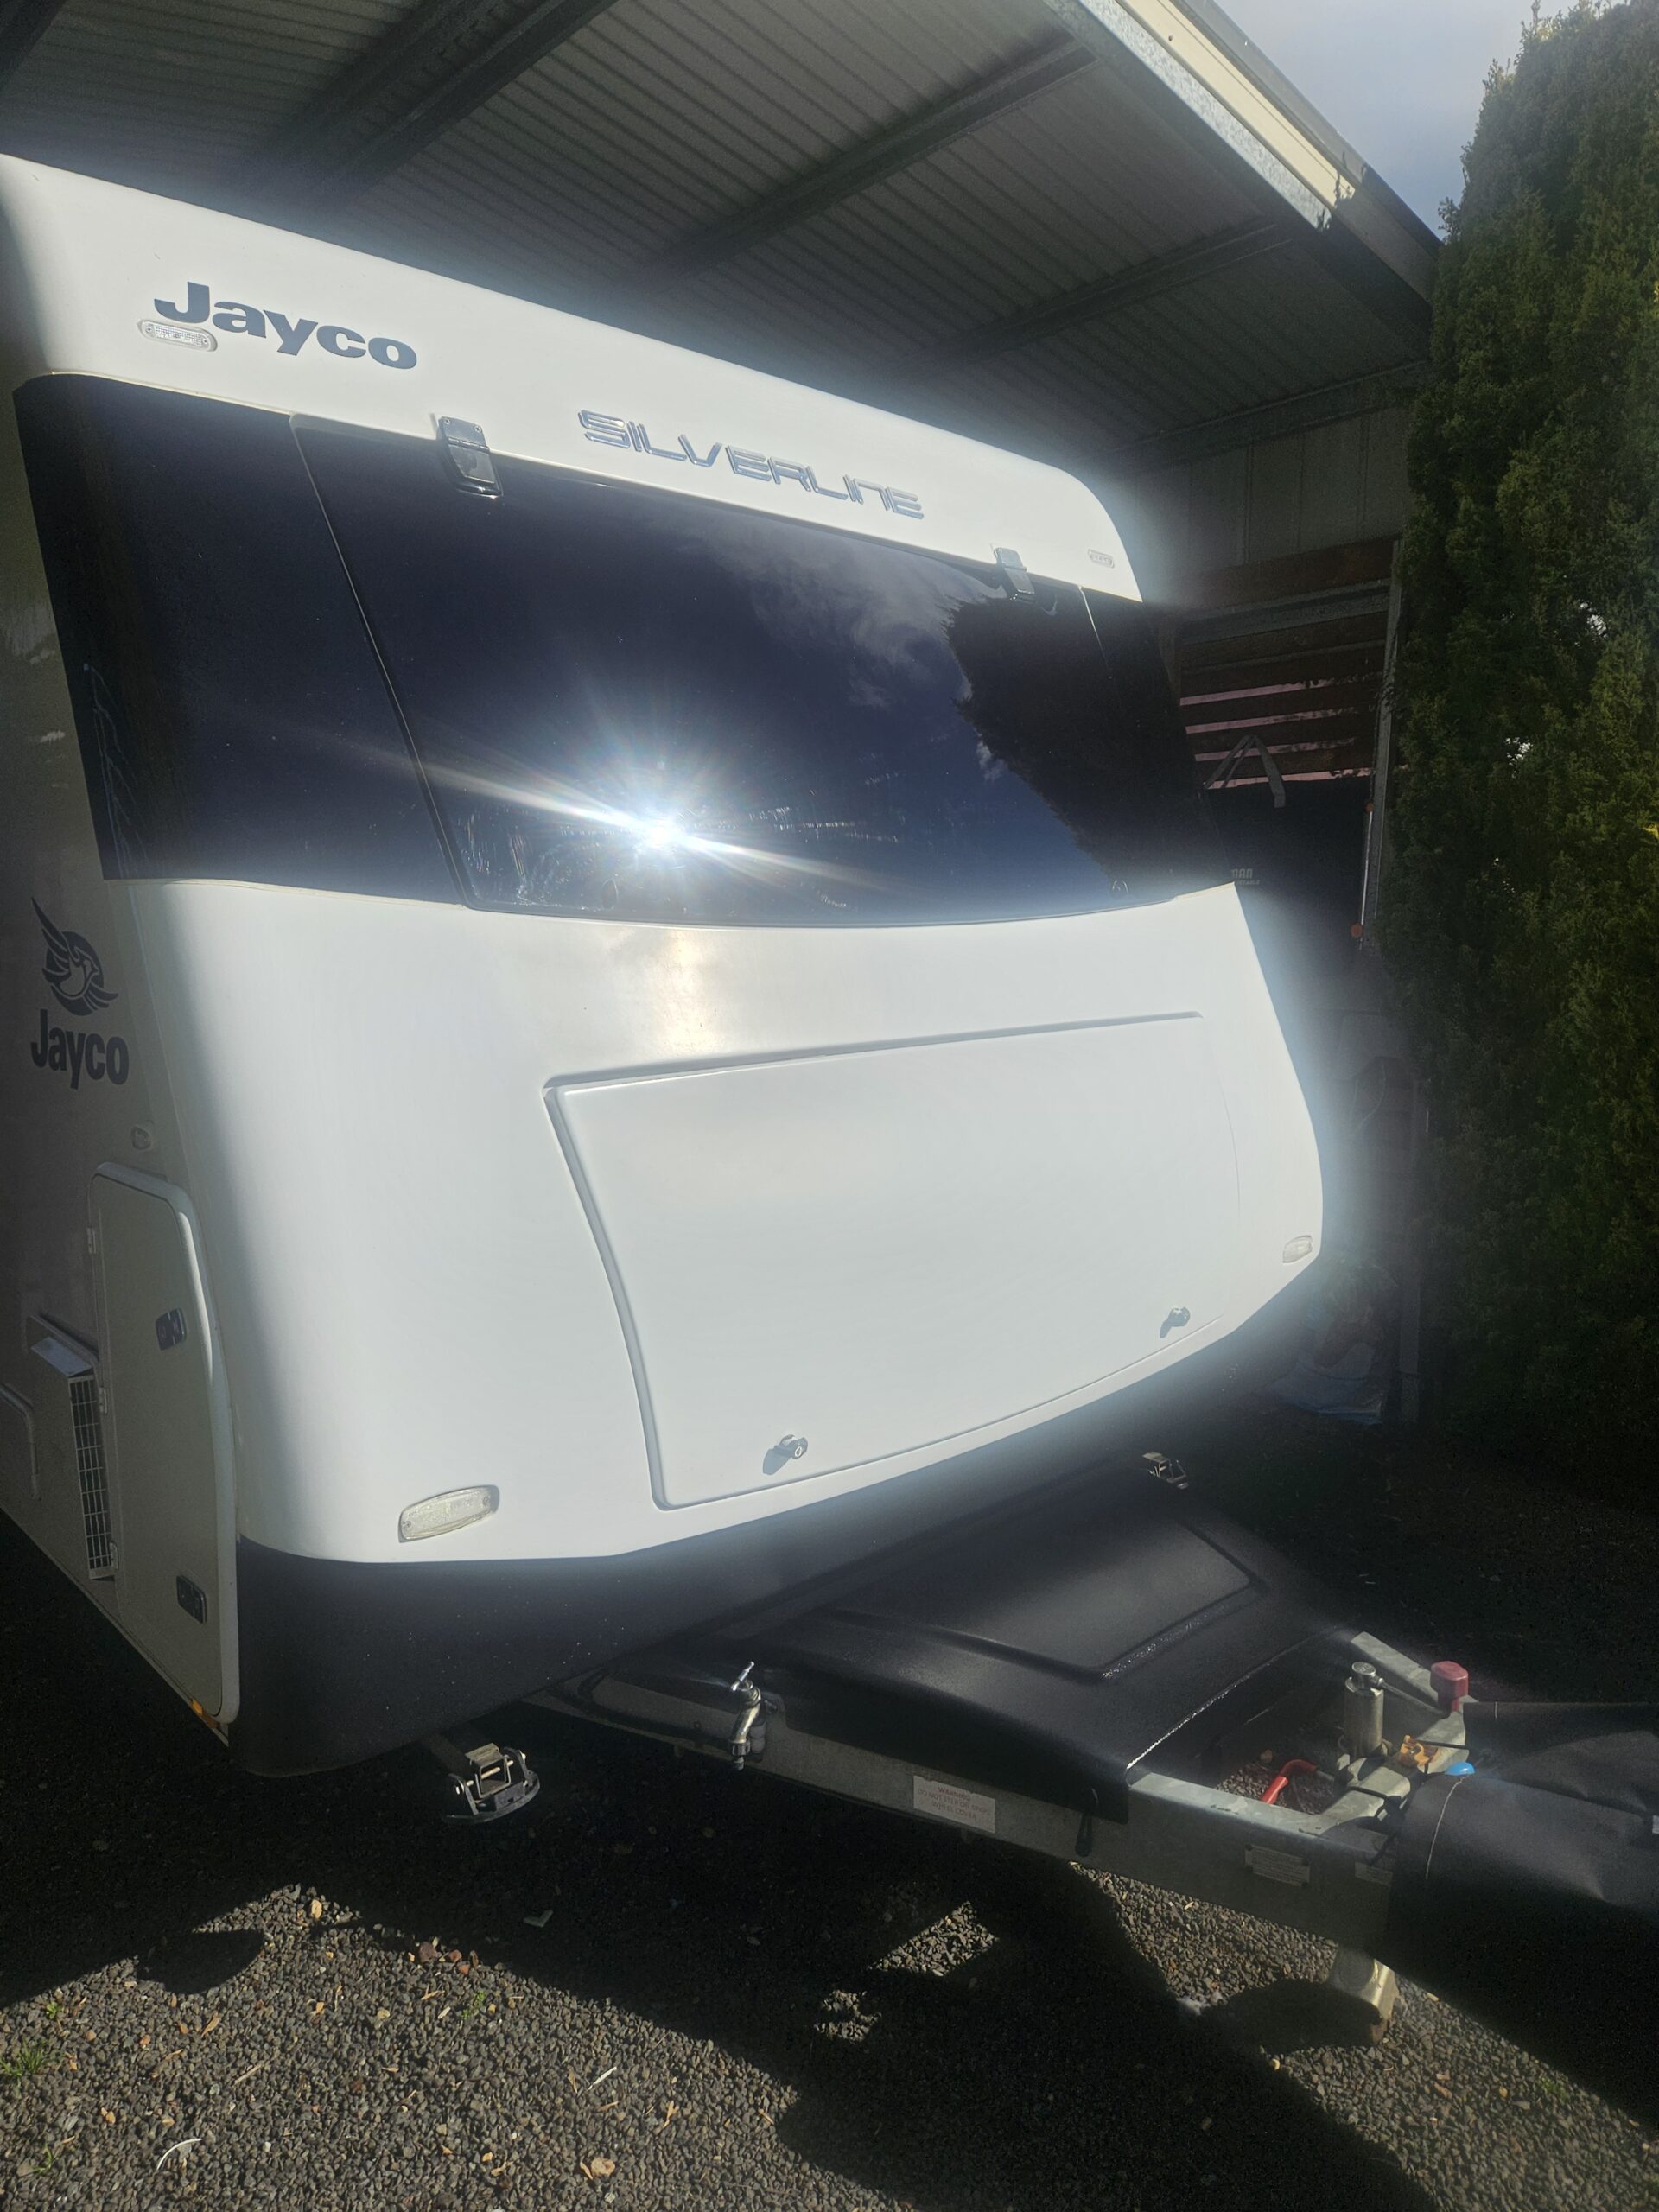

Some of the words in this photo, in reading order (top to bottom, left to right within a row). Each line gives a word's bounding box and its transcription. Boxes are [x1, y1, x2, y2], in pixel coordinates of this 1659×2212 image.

[154, 281, 417, 370] Jayco
[577, 409, 925, 520] SILVERLINE
[30, 1008, 130, 1090] Jayco
